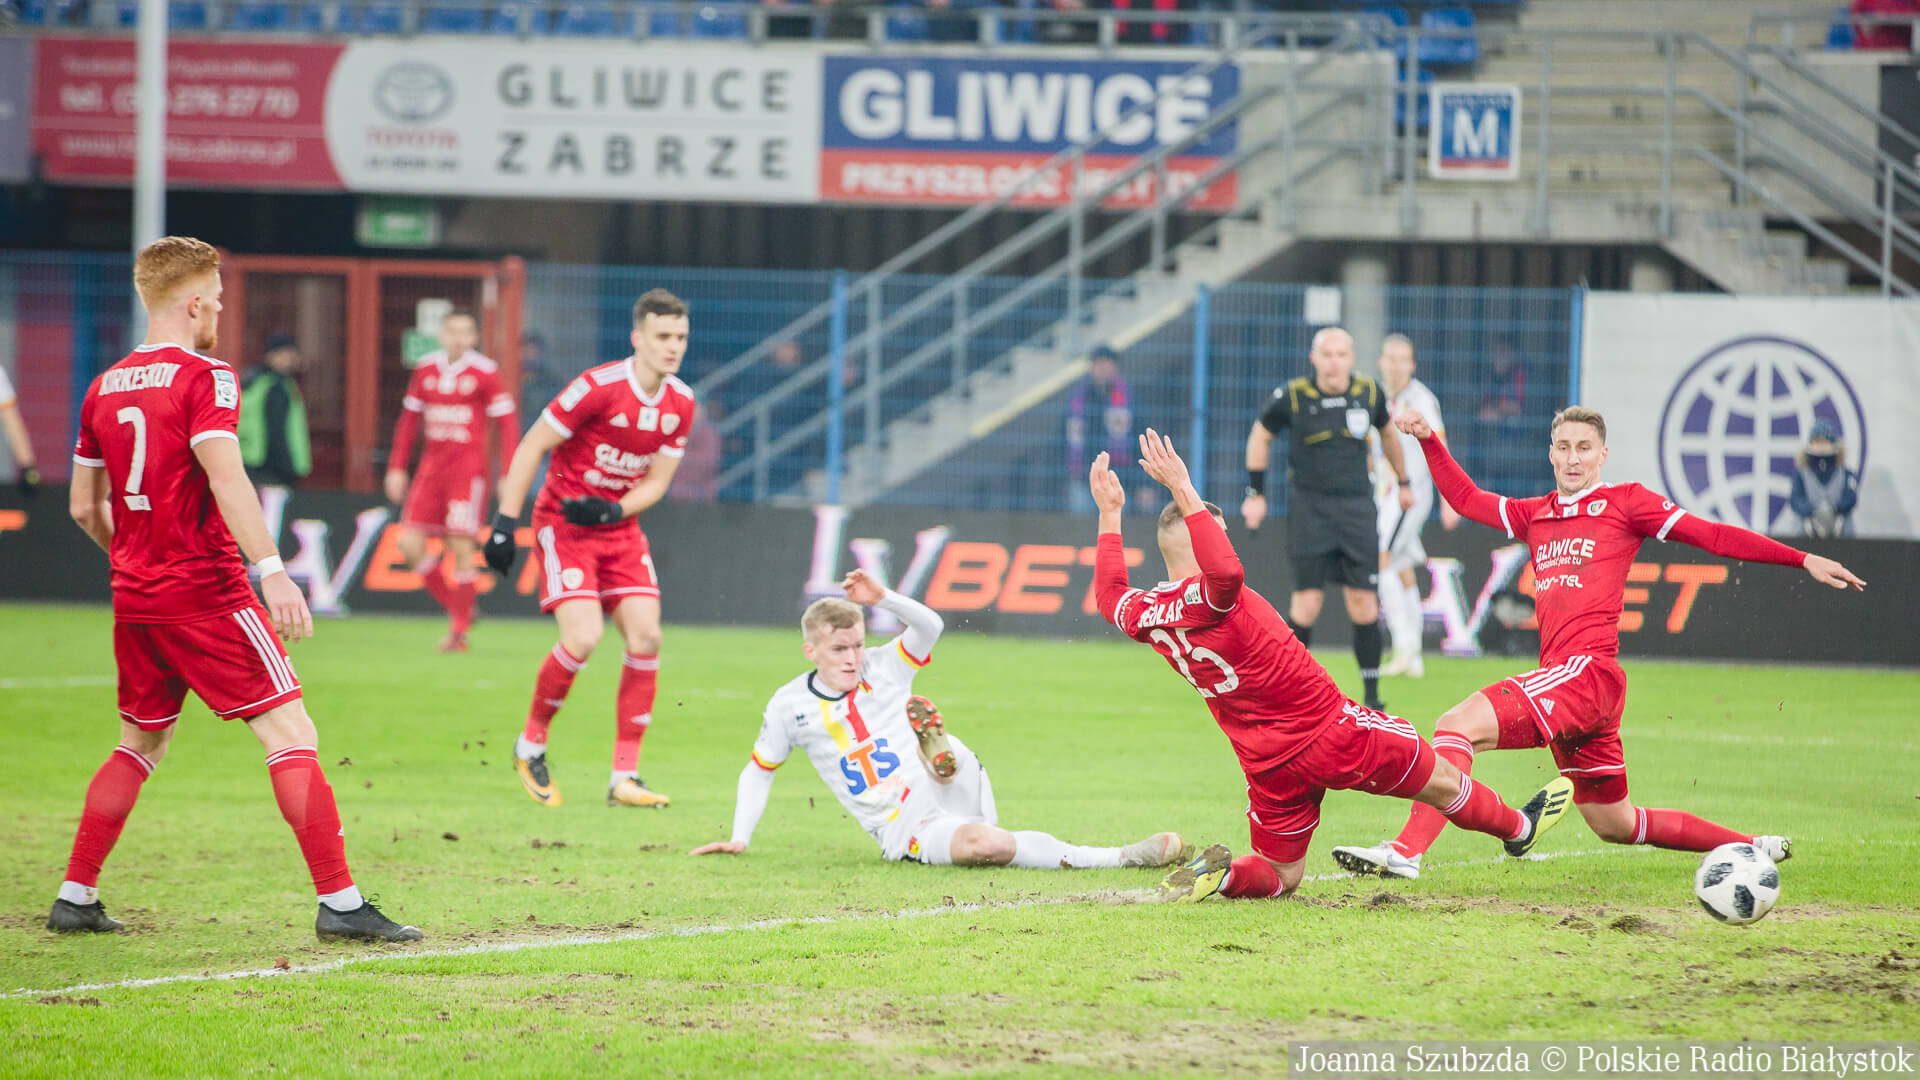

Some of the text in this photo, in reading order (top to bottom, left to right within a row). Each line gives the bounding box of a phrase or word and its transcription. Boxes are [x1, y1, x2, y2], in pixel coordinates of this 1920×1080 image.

[497, 64, 790, 112] GLIWICE
[838, 68, 1212, 146] GLIWICE
[1453, 107, 1498, 154] M
[497, 131, 790, 180] ZABRZE
[1536, 537, 1596, 563] GLIWICE
[1150, 627, 1239, 698] 25
[840, 738, 901, 796] STS
